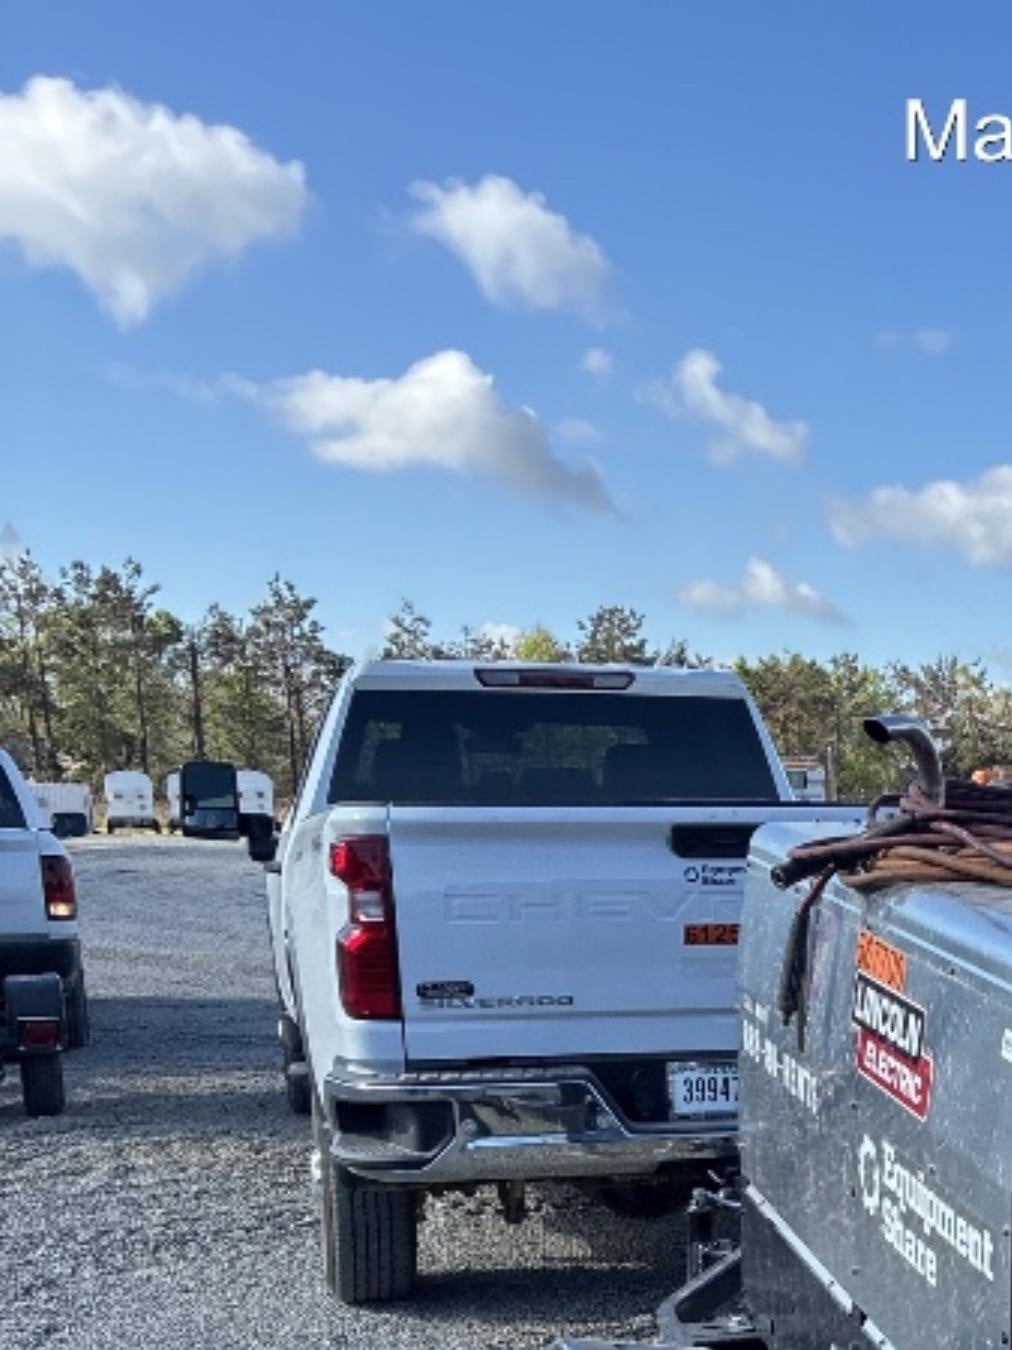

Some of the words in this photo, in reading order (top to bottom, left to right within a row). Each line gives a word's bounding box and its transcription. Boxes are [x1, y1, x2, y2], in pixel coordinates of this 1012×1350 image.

[419, 995, 574, 1011] SILVERADO
[854, 981, 922, 1057] LINCOLN
[863, 1040, 922, 1105] ELECTRIC
[881, 1195, 937, 1288] Share
[882, 1137, 993, 1282] Equipment
